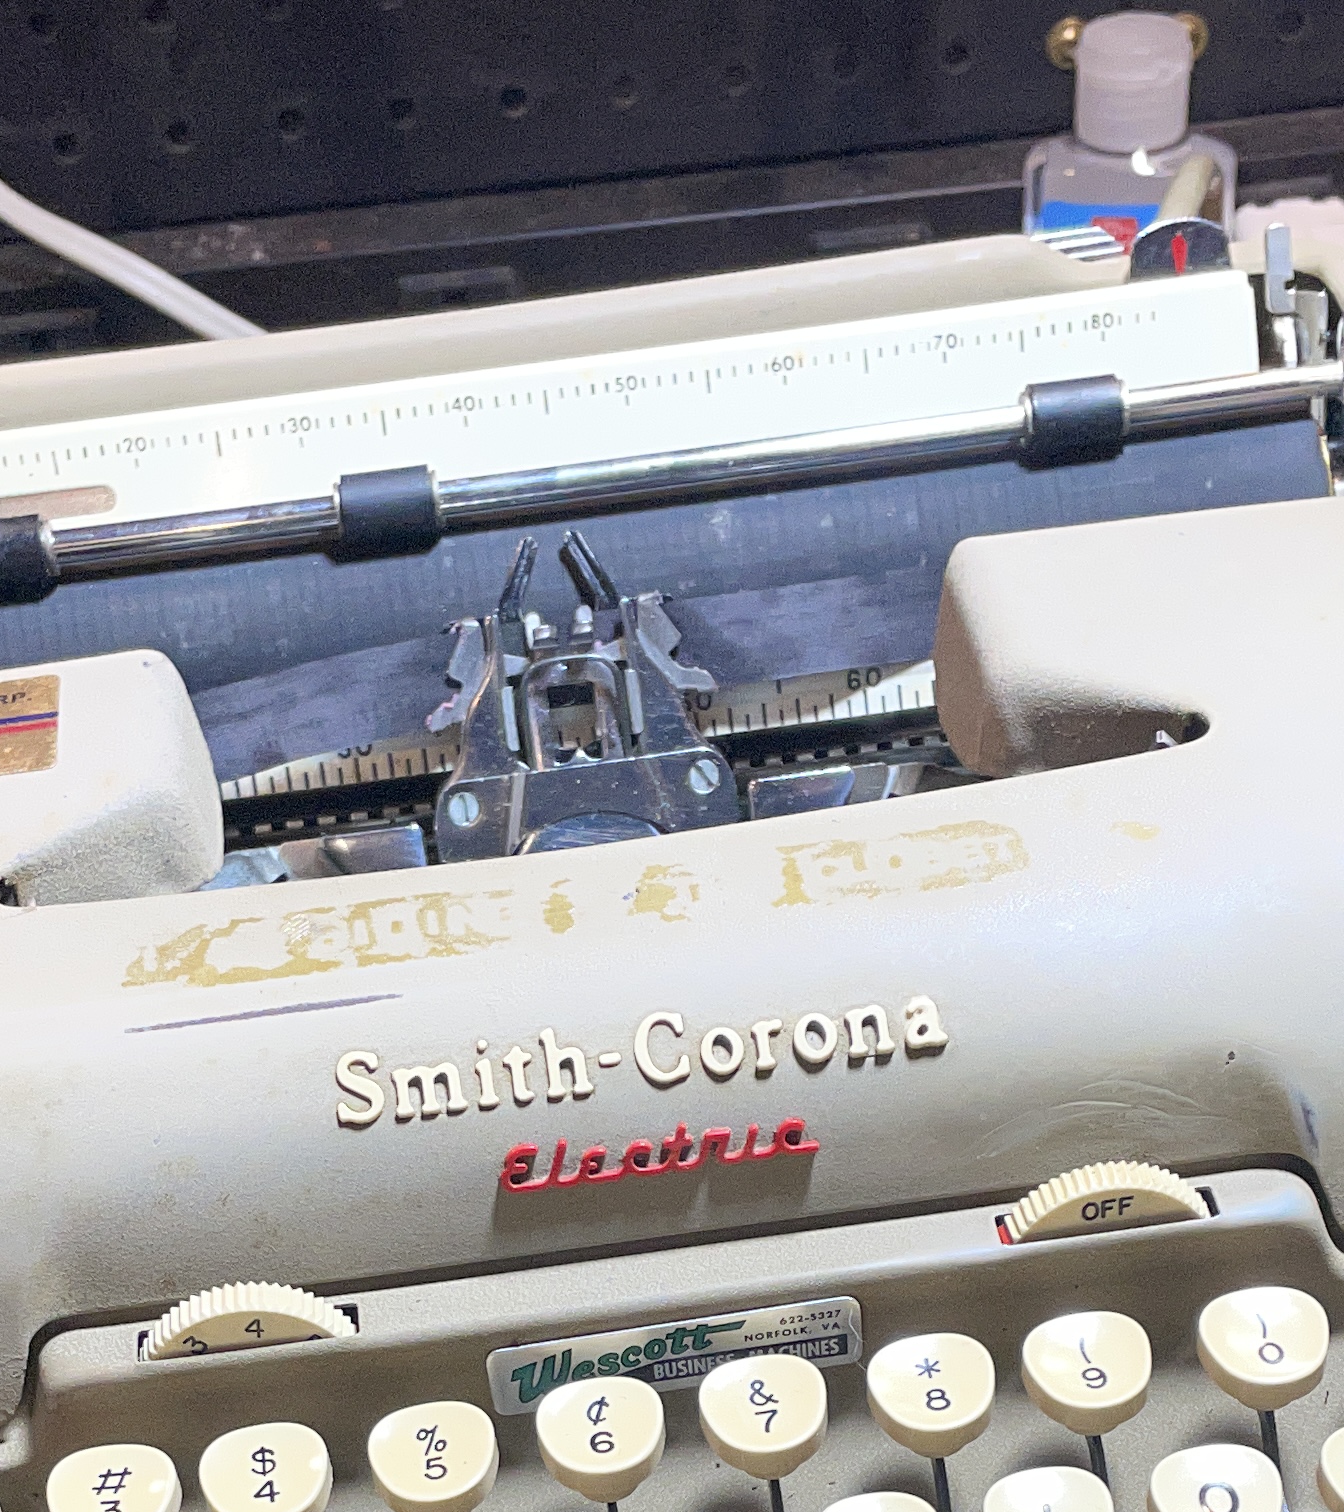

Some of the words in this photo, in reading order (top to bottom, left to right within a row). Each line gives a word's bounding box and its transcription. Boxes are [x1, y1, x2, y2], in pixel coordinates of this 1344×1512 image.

[123, 436, 147, 453] 20
[288, 417, 311, 434] 30
[452, 395, 476, 412] 40
[614, 376, 638, 393] 50
[771, 356, 794, 373] 60
[934, 333, 958, 350] 70
[1091, 313, 1114, 329] 80
[847, 666, 882, 690] 60
[335, 994, 949, 1125] Smith-Corona
[501, 1117, 820, 1193] Electric
[1080, 1196, 1134, 1220] OFF
[244, 1318, 265, 1339] 4
[780, 1309, 841, 1325] 622-5327
[511, 1320, 746, 1403] Wescott
[1081, 1367, 1108, 1390] 9
[749, 1379, 779, 1405] &
[925, 1388, 951, 1411] 8
[586, 1396, 609, 1426] ¢
[754, 1410, 777, 1434] 7
[416, 1425, 448, 1457] %
[589, 1431, 615, 1454] 6
[251, 1447, 277, 1478] $
[424, 1457, 448, 1481] 5
[92, 1466, 132, 1494] #
[253, 1480, 281, 1504] 4
